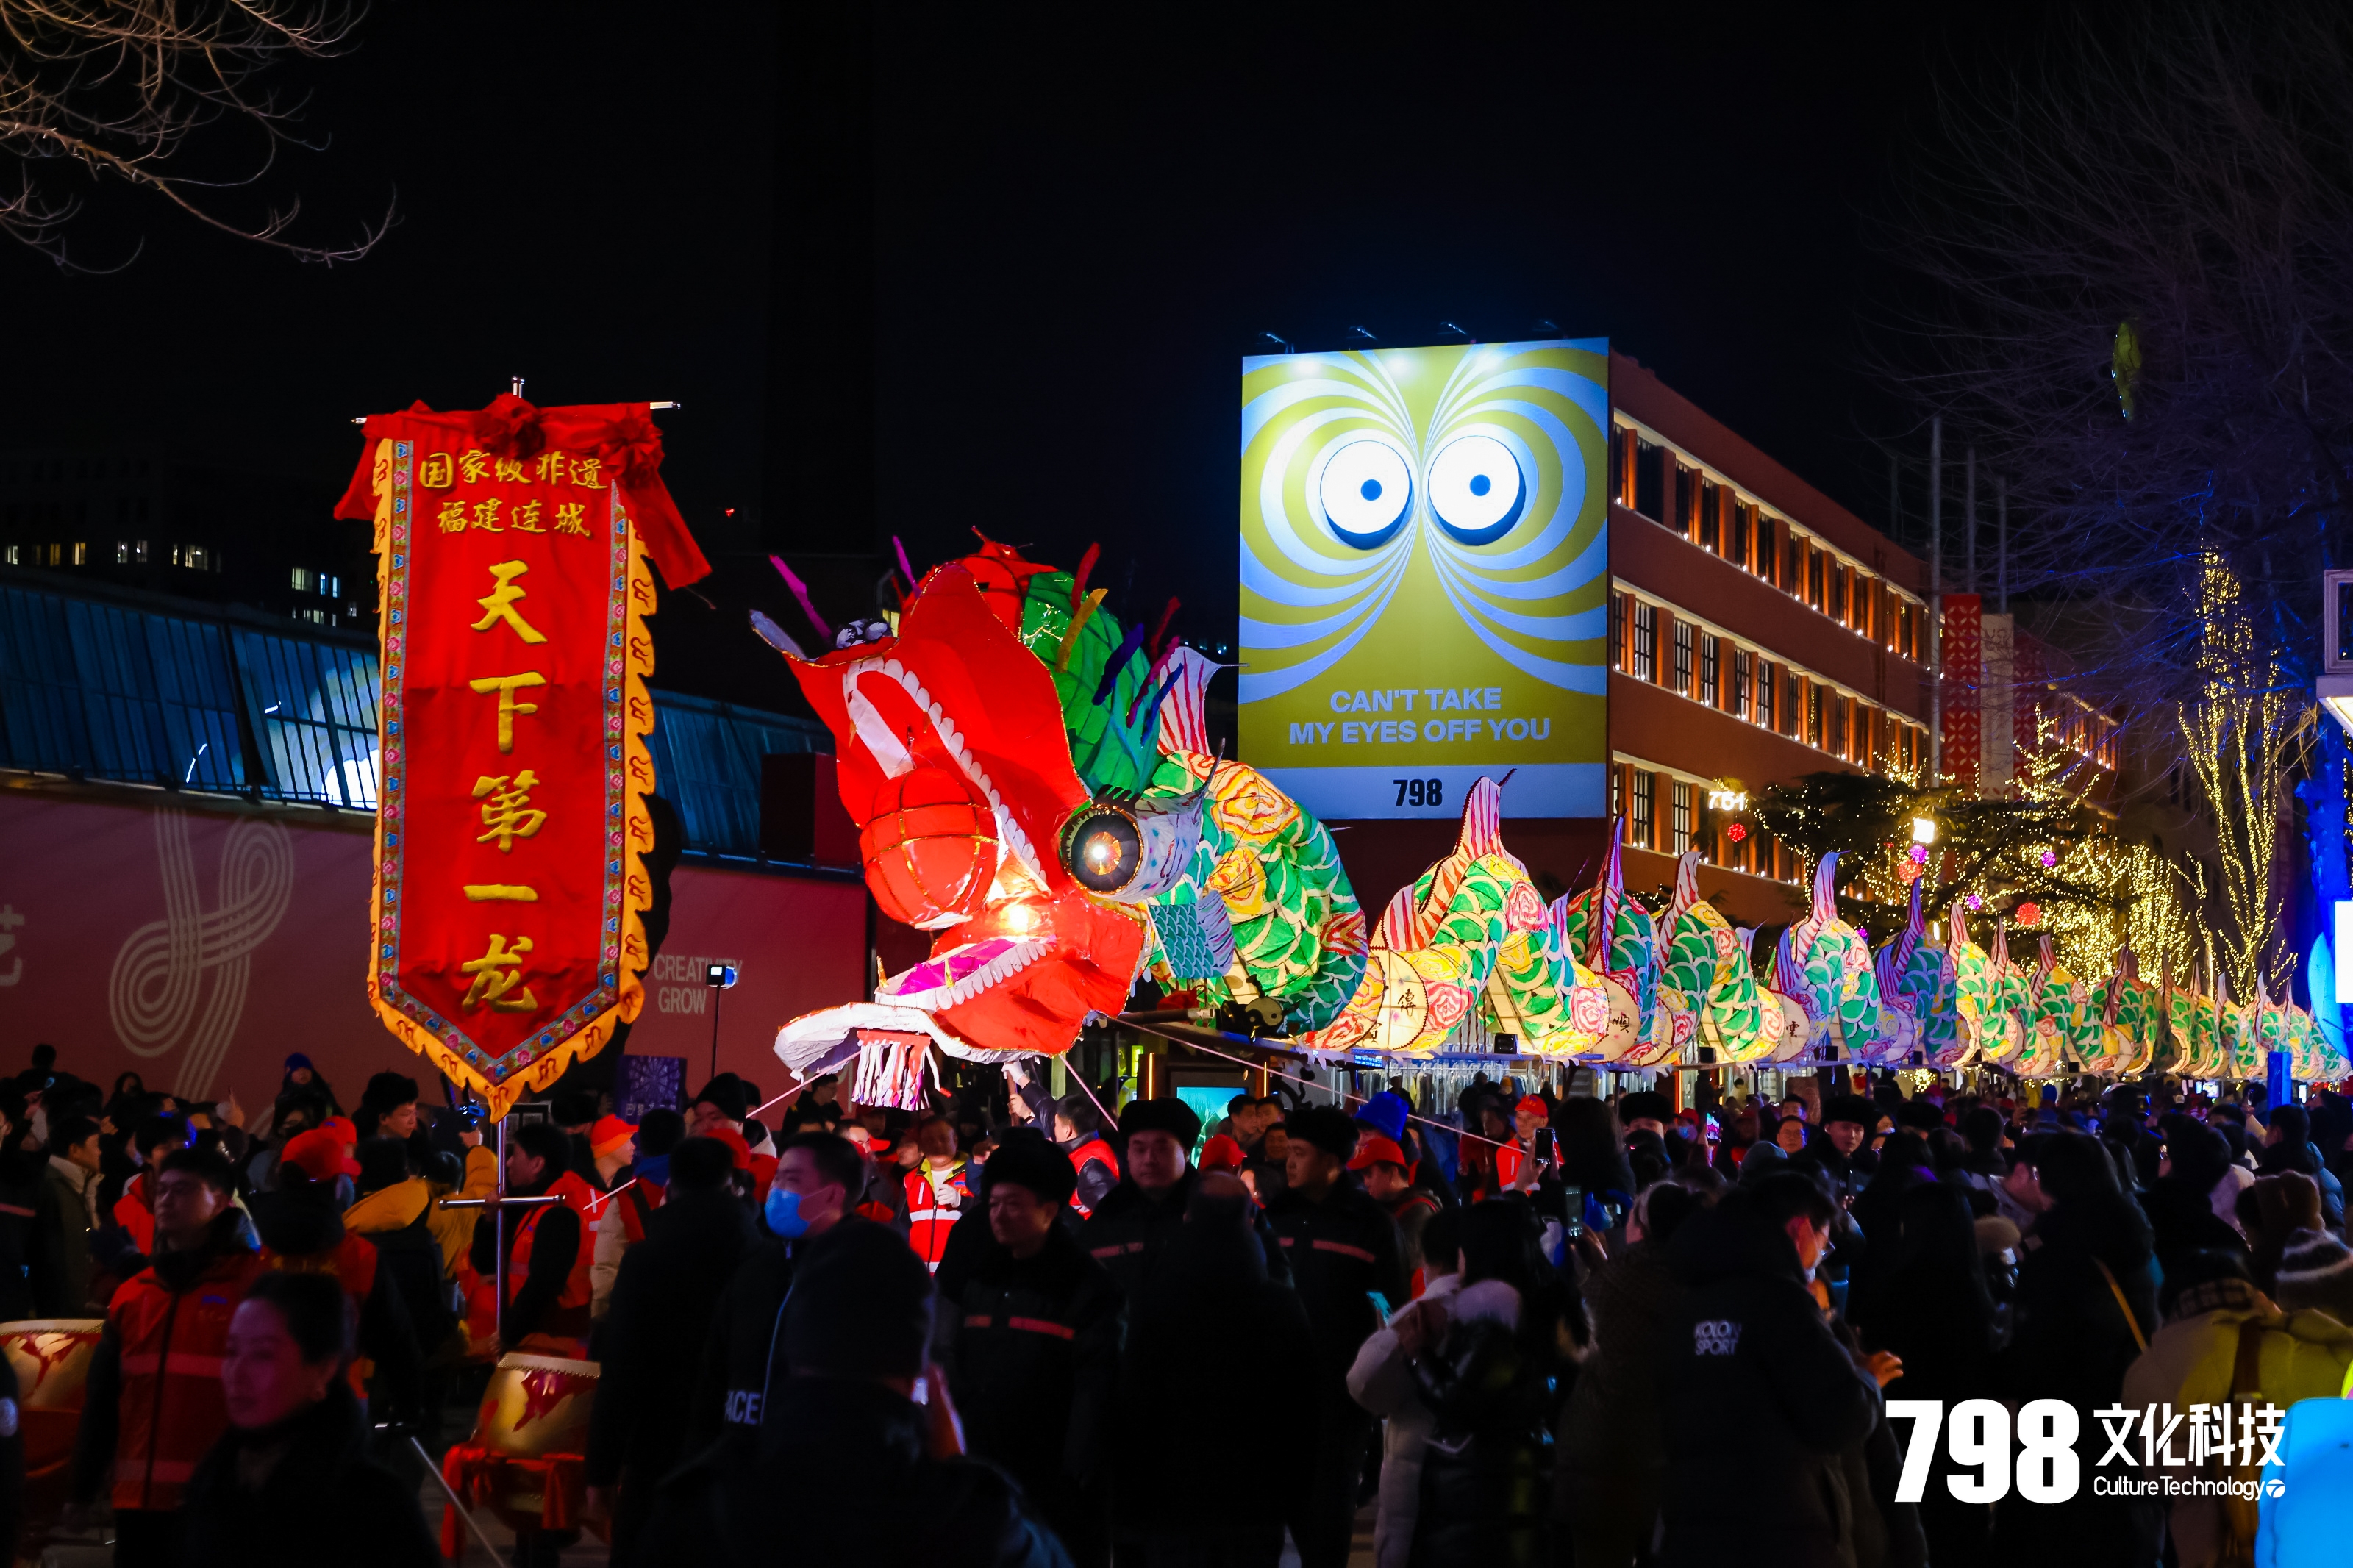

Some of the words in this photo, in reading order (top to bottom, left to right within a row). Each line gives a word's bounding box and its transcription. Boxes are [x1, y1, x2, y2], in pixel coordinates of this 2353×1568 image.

[419, 448, 607, 490] 国家级非遗
[436, 498, 591, 538] 福建连城
[1330, 690, 1419, 712] CAN'T
[1424, 687, 1502, 711] TAKE
[1290, 722, 1335, 745] MY
[1342, 720, 1418, 743] EYES
[1424, 719, 1482, 742] OFF
[1488, 718, 1551, 741] YOU
[462, 560, 548, 1014] 天下第一龙
[1393, 779, 1443, 807] 798
[658, 987, 707, 1014] GROW
[1695, 1339, 1736, 1356] SPORT
